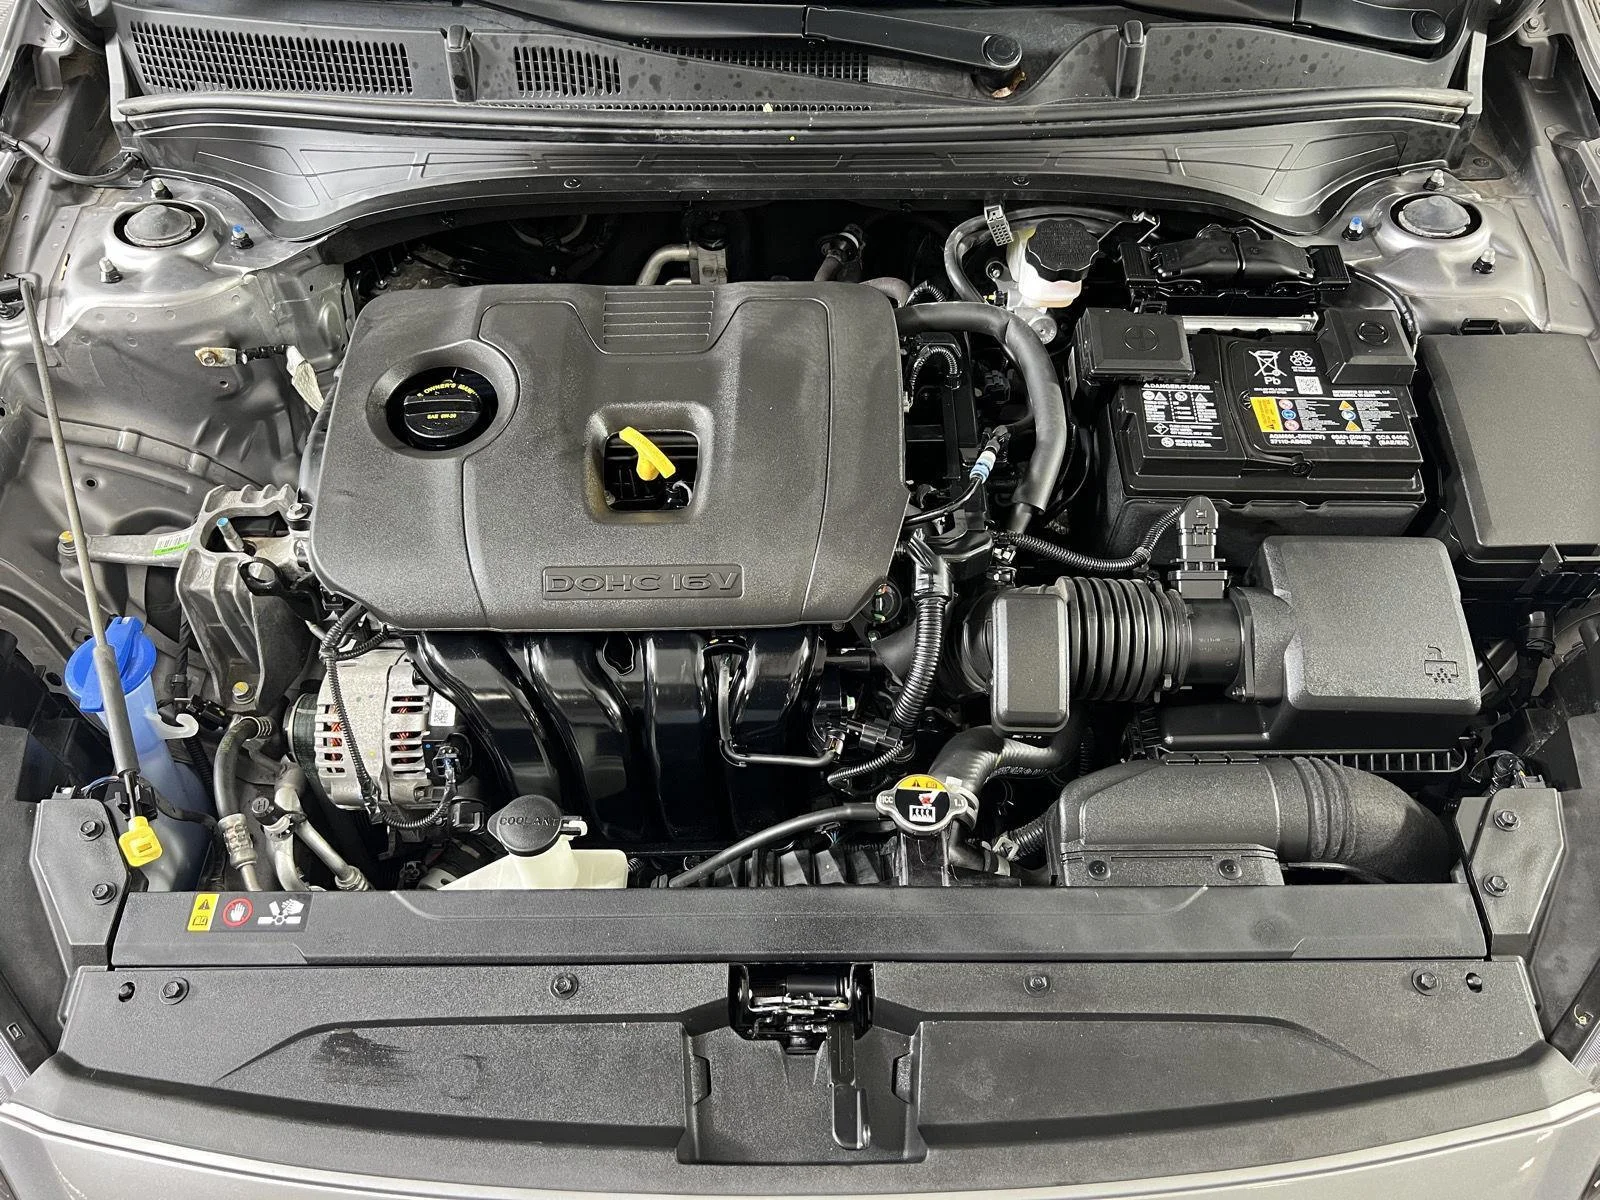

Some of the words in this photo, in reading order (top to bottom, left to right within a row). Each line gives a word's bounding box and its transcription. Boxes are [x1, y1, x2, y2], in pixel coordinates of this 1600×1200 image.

[1264, 376, 1281, 385] Pb
[424, 383, 457, 394] OWNER'S
[546, 573, 663, 593] DOHC
[671, 572, 740, 591] 16V
[499, 816, 559, 827] COOLANT
